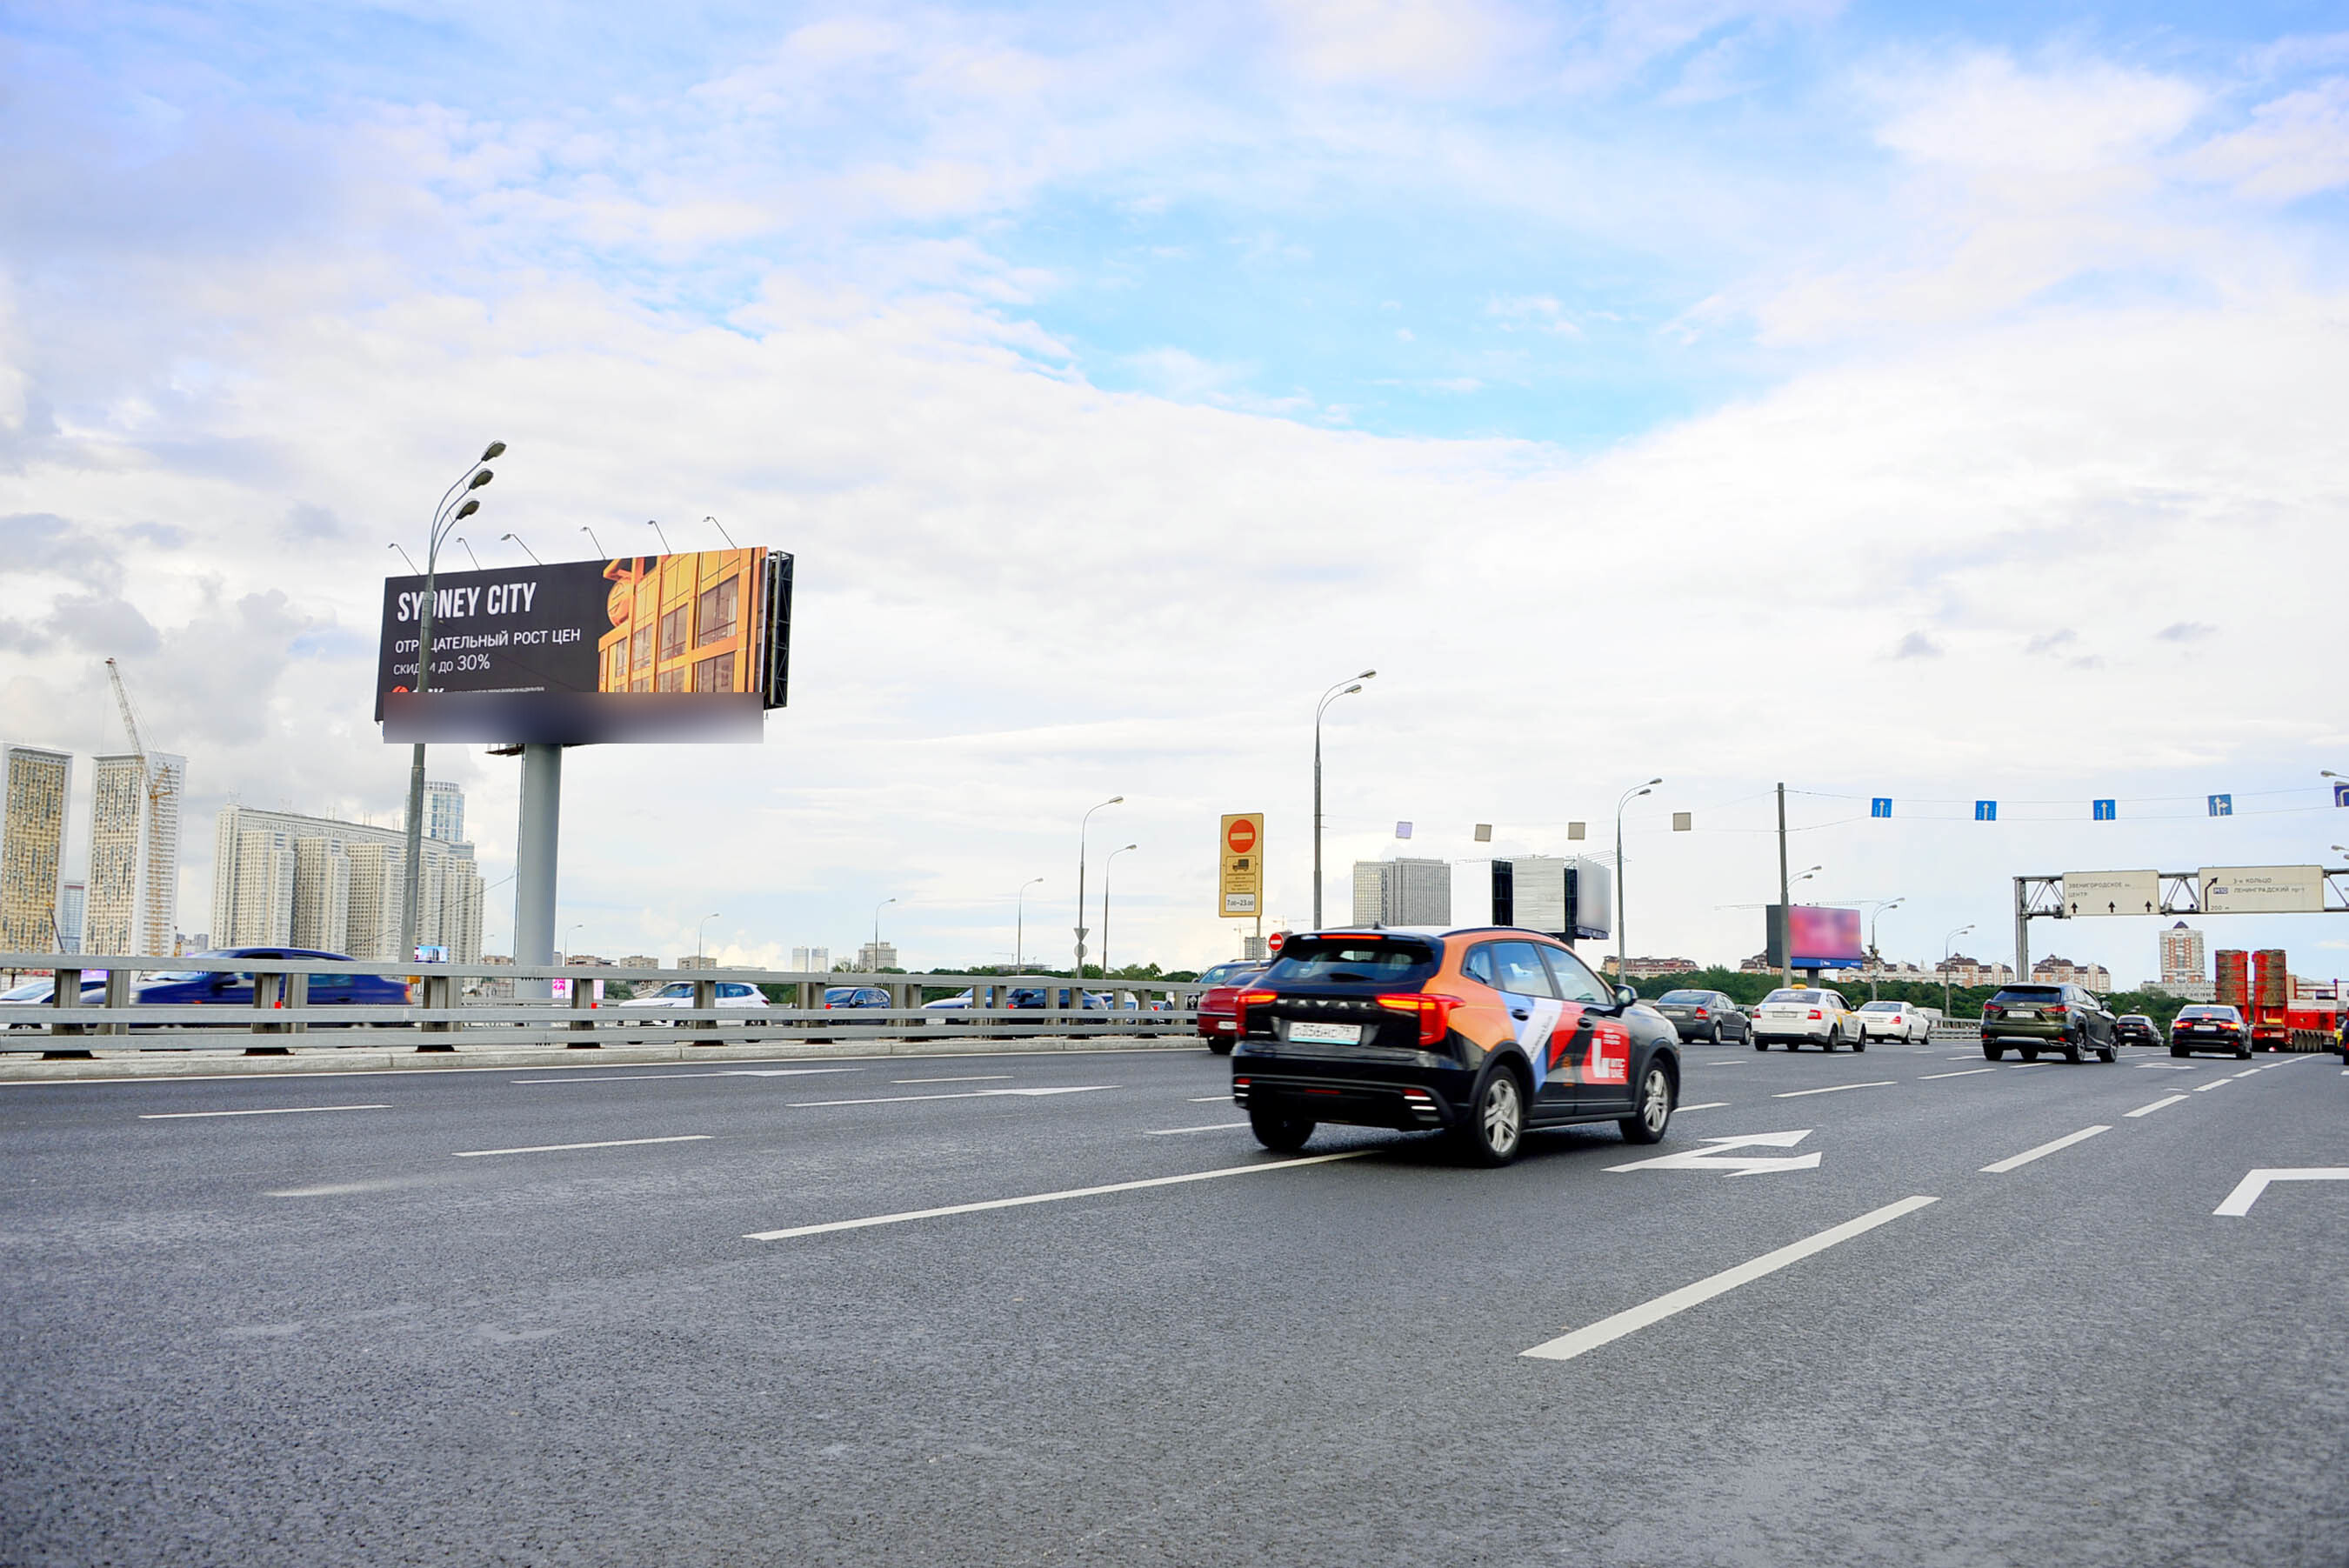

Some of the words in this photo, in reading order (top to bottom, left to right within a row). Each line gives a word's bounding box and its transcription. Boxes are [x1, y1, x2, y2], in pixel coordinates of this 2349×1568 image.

[487, 582, 537, 615] CITY
[395, 630, 509, 653] ОТРЦАТЕЛЬНЫЙ
[513, 631, 548, 645] РОСТ
[551, 628, 581, 644] ЦЕН
[393, 661, 435, 675] СКИДИ
[437, 661, 453, 674] ДО
[457, 653, 490, 671] 30%
